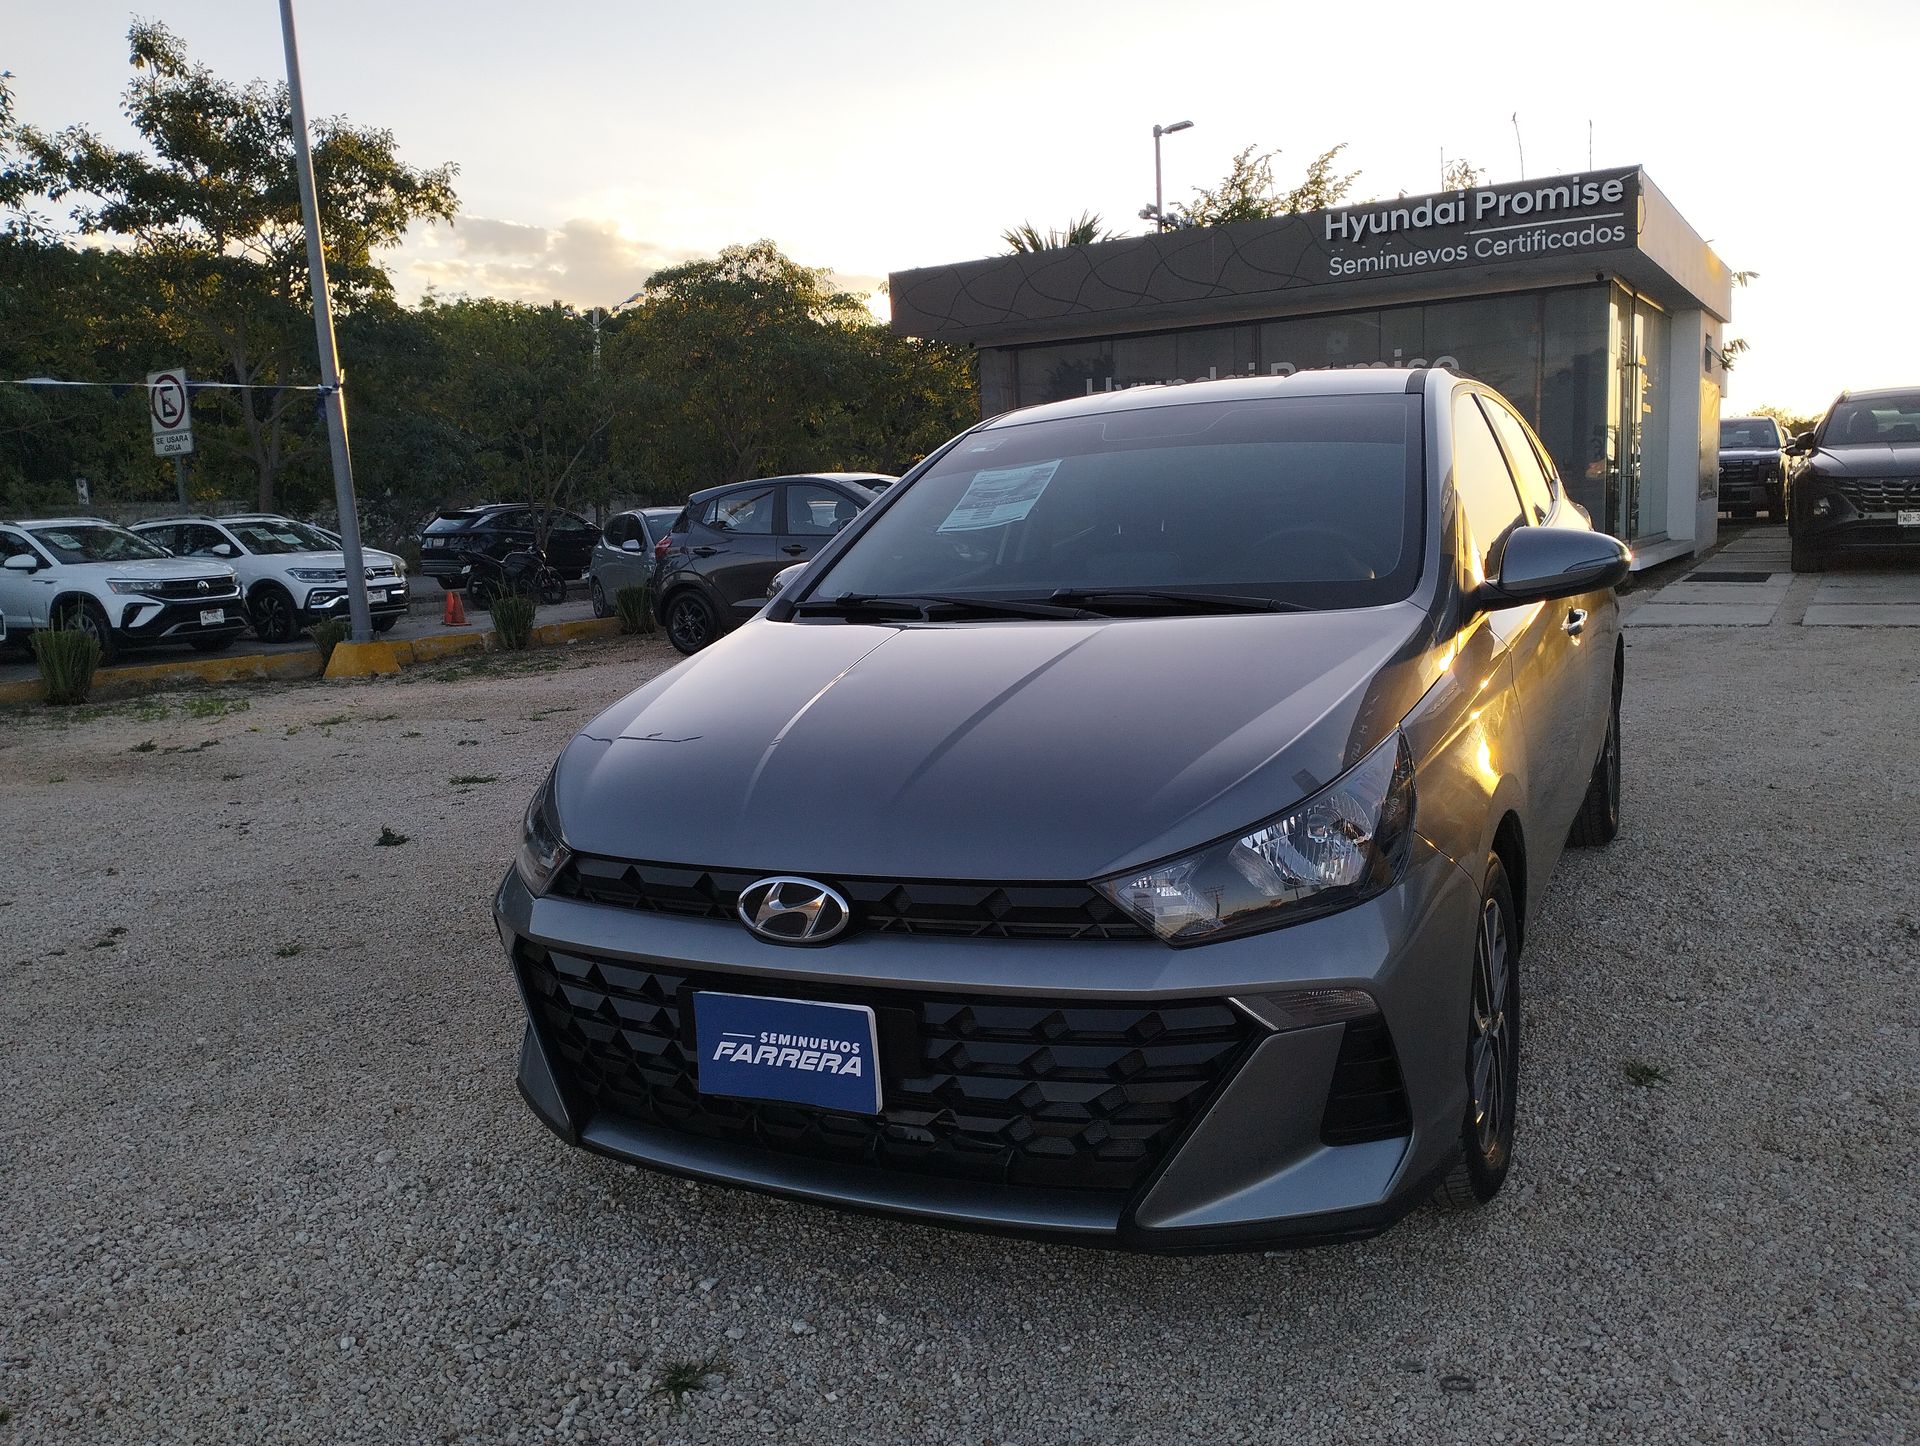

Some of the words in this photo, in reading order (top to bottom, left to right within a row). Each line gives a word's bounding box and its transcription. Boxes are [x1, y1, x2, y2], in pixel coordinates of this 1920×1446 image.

[1325, 192, 1465, 242] Hyundai
[1476, 176, 1624, 219] Promise
[1328, 243, 1468, 276] Seminuevos
[1474, 223, 1626, 258] Certificados
[166, 434, 188, 443] USARA
[712, 1041, 863, 1077] FARRERA
[759, 1031, 861, 1055] SEMINUEVOS
